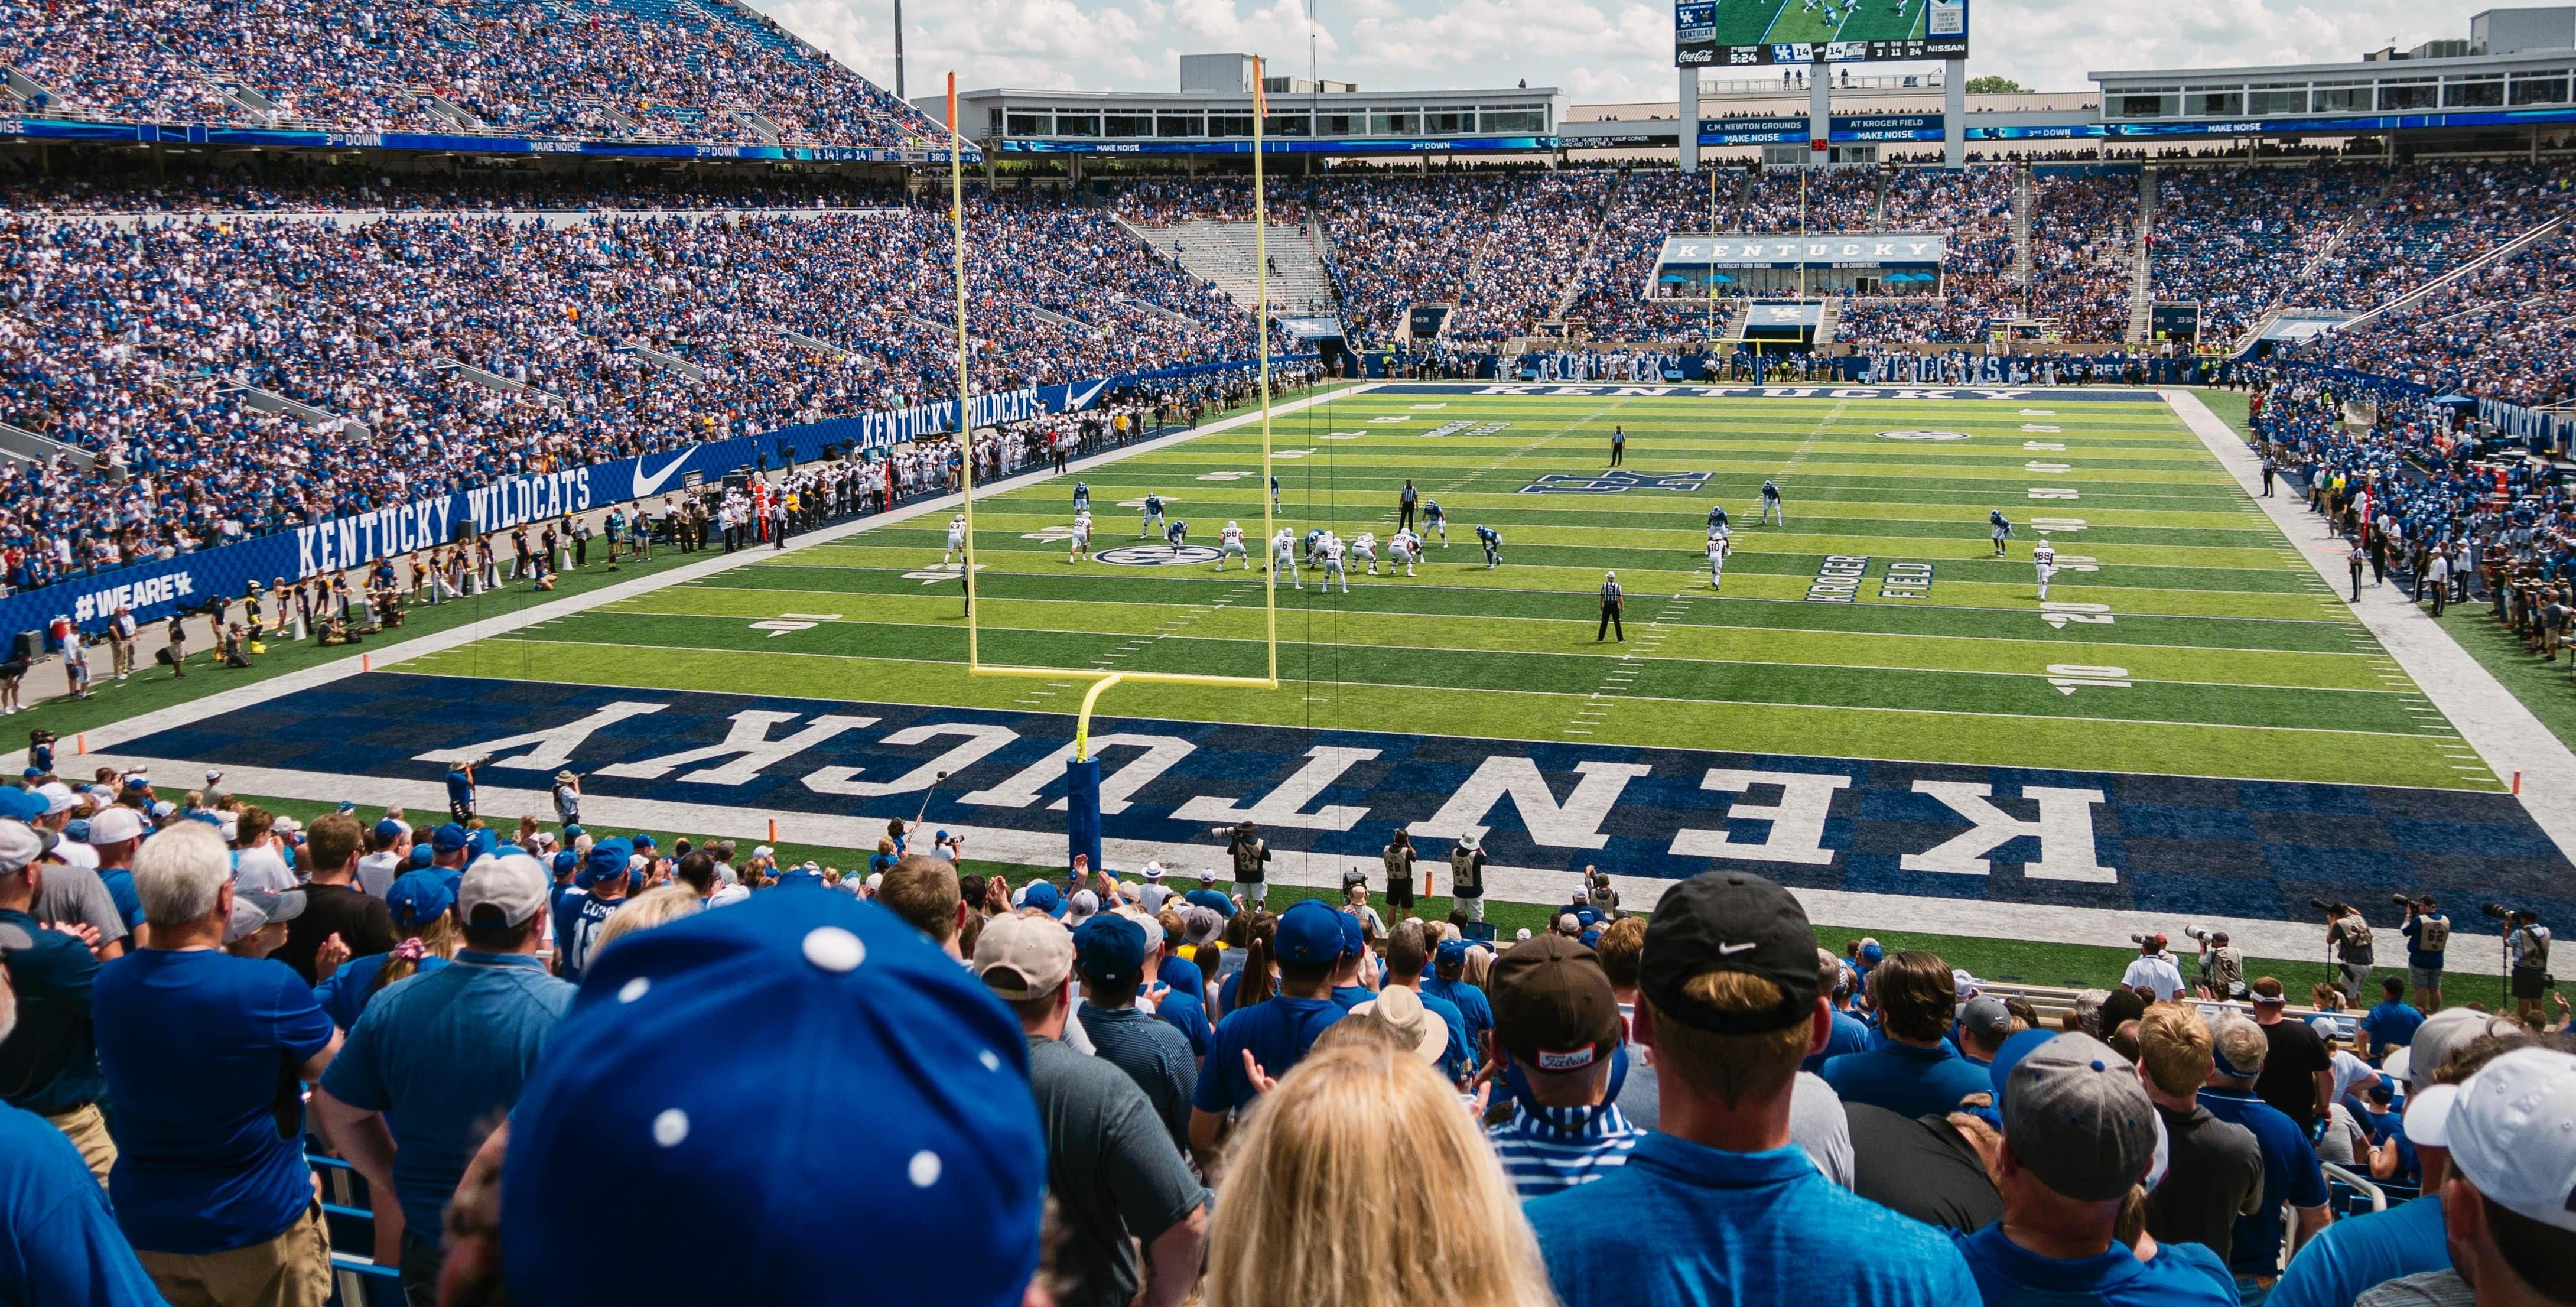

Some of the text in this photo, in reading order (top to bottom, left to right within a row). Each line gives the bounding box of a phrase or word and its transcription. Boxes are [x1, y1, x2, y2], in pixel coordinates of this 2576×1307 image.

[1679, 30, 1712, 38] KENTUCKY
[1796, 48, 1810, 56] 14
[1731, 53, 1757, 63] 5:24
[2207, 123, 2262, 132] MAKE NOISE
[326, 134, 382, 146] 3RD DOWN
[1751, 134, 1780, 142] NOISE
[1885, 131, 1914, 139] NOISE
[531, 142, 581, 152] MAKE NOISE
[1813, 140, 1827, 151] 35
[697, 147, 739, 157] 3RD DOWN
[824, 150, 834, 160] 14
[856, 150, 866, 160] 14
[884, 152, 901, 161] 5:24
[931, 153, 945, 161] 3RD
[972, 154, 981, 162] 24
[1678, 244, 1928, 257] KENTUCKY
[1485, 386, 2031, 399] KENTUCKY
[863, 401, 953, 449] KENTUCKY
[298, 467, 591, 580] KENTUCKY WILDCATS
[1282, 541, 1288, 550] 6
[1711, 542, 1720, 552] 10
[2038, 552, 2050, 560] 88
[1804, 555, 1934, 602] KROGER FIELD
[1607, 586, 1614, 595] R
[2046, 664, 2132, 688] 10
[412, 702, 2118, 884] KENTUCKY
[1241, 853, 1254, 864] 34
[1388, 861, 1400, 873] 28
[1455, 866, 1468, 878] 64
[2428, 929, 2444, 942] 62
